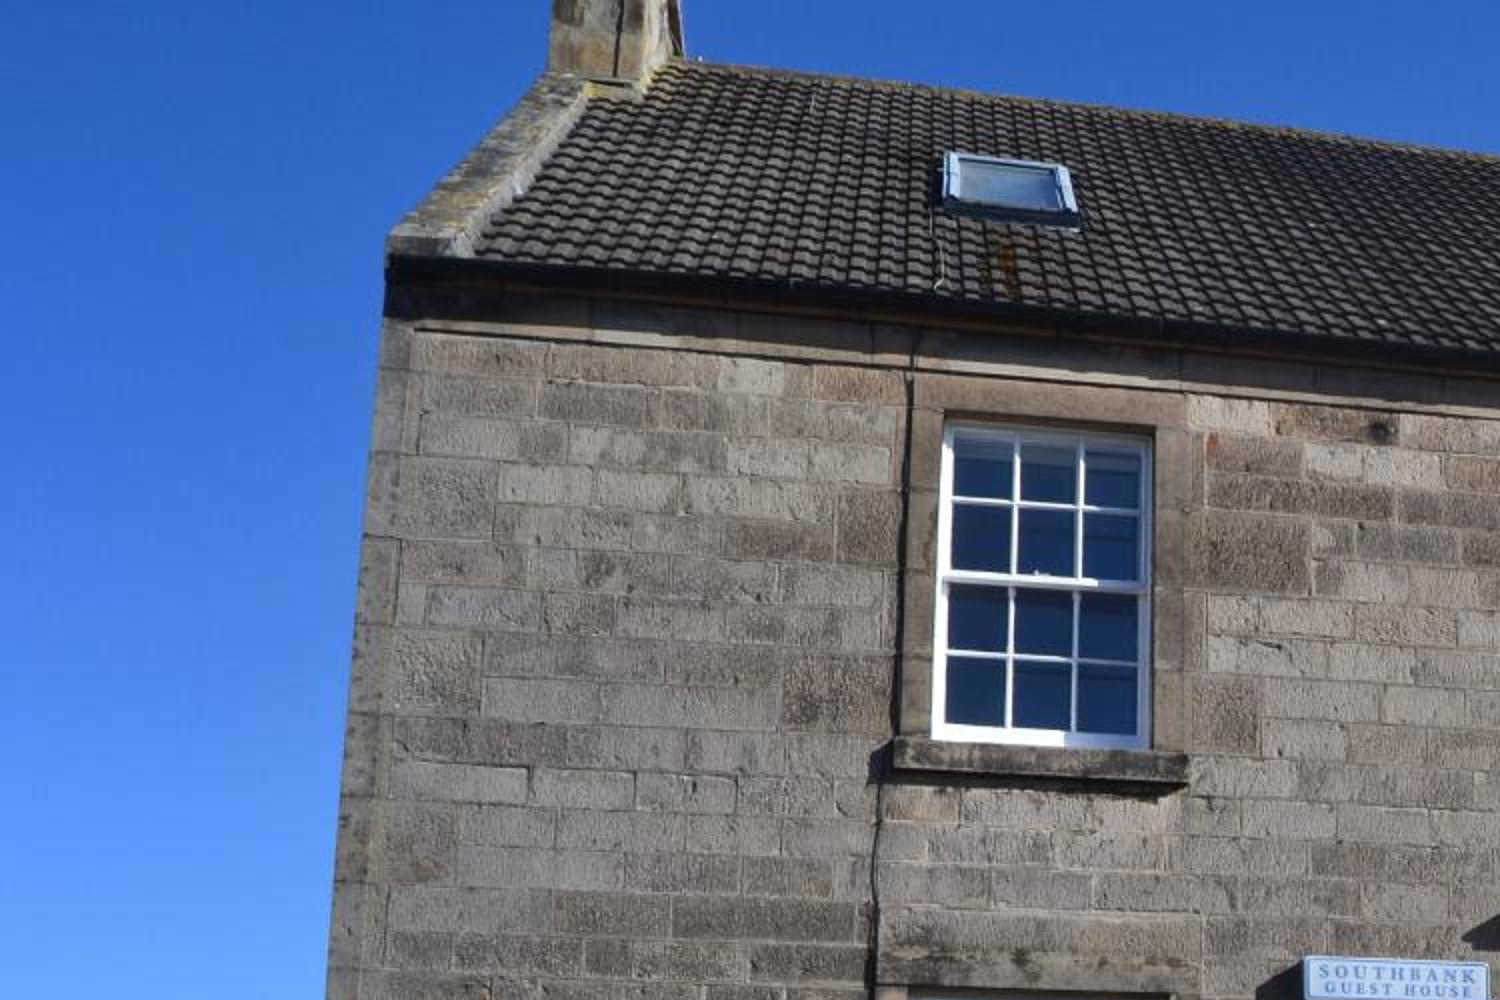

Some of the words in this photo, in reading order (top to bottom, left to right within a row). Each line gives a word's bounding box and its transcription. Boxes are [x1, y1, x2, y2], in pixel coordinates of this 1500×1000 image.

[1318, 963, 1476, 984] SOUTHBANK
[1325, 981, 1392, 995] GUEST
[1404, 984, 1473, 998] HOUSE
